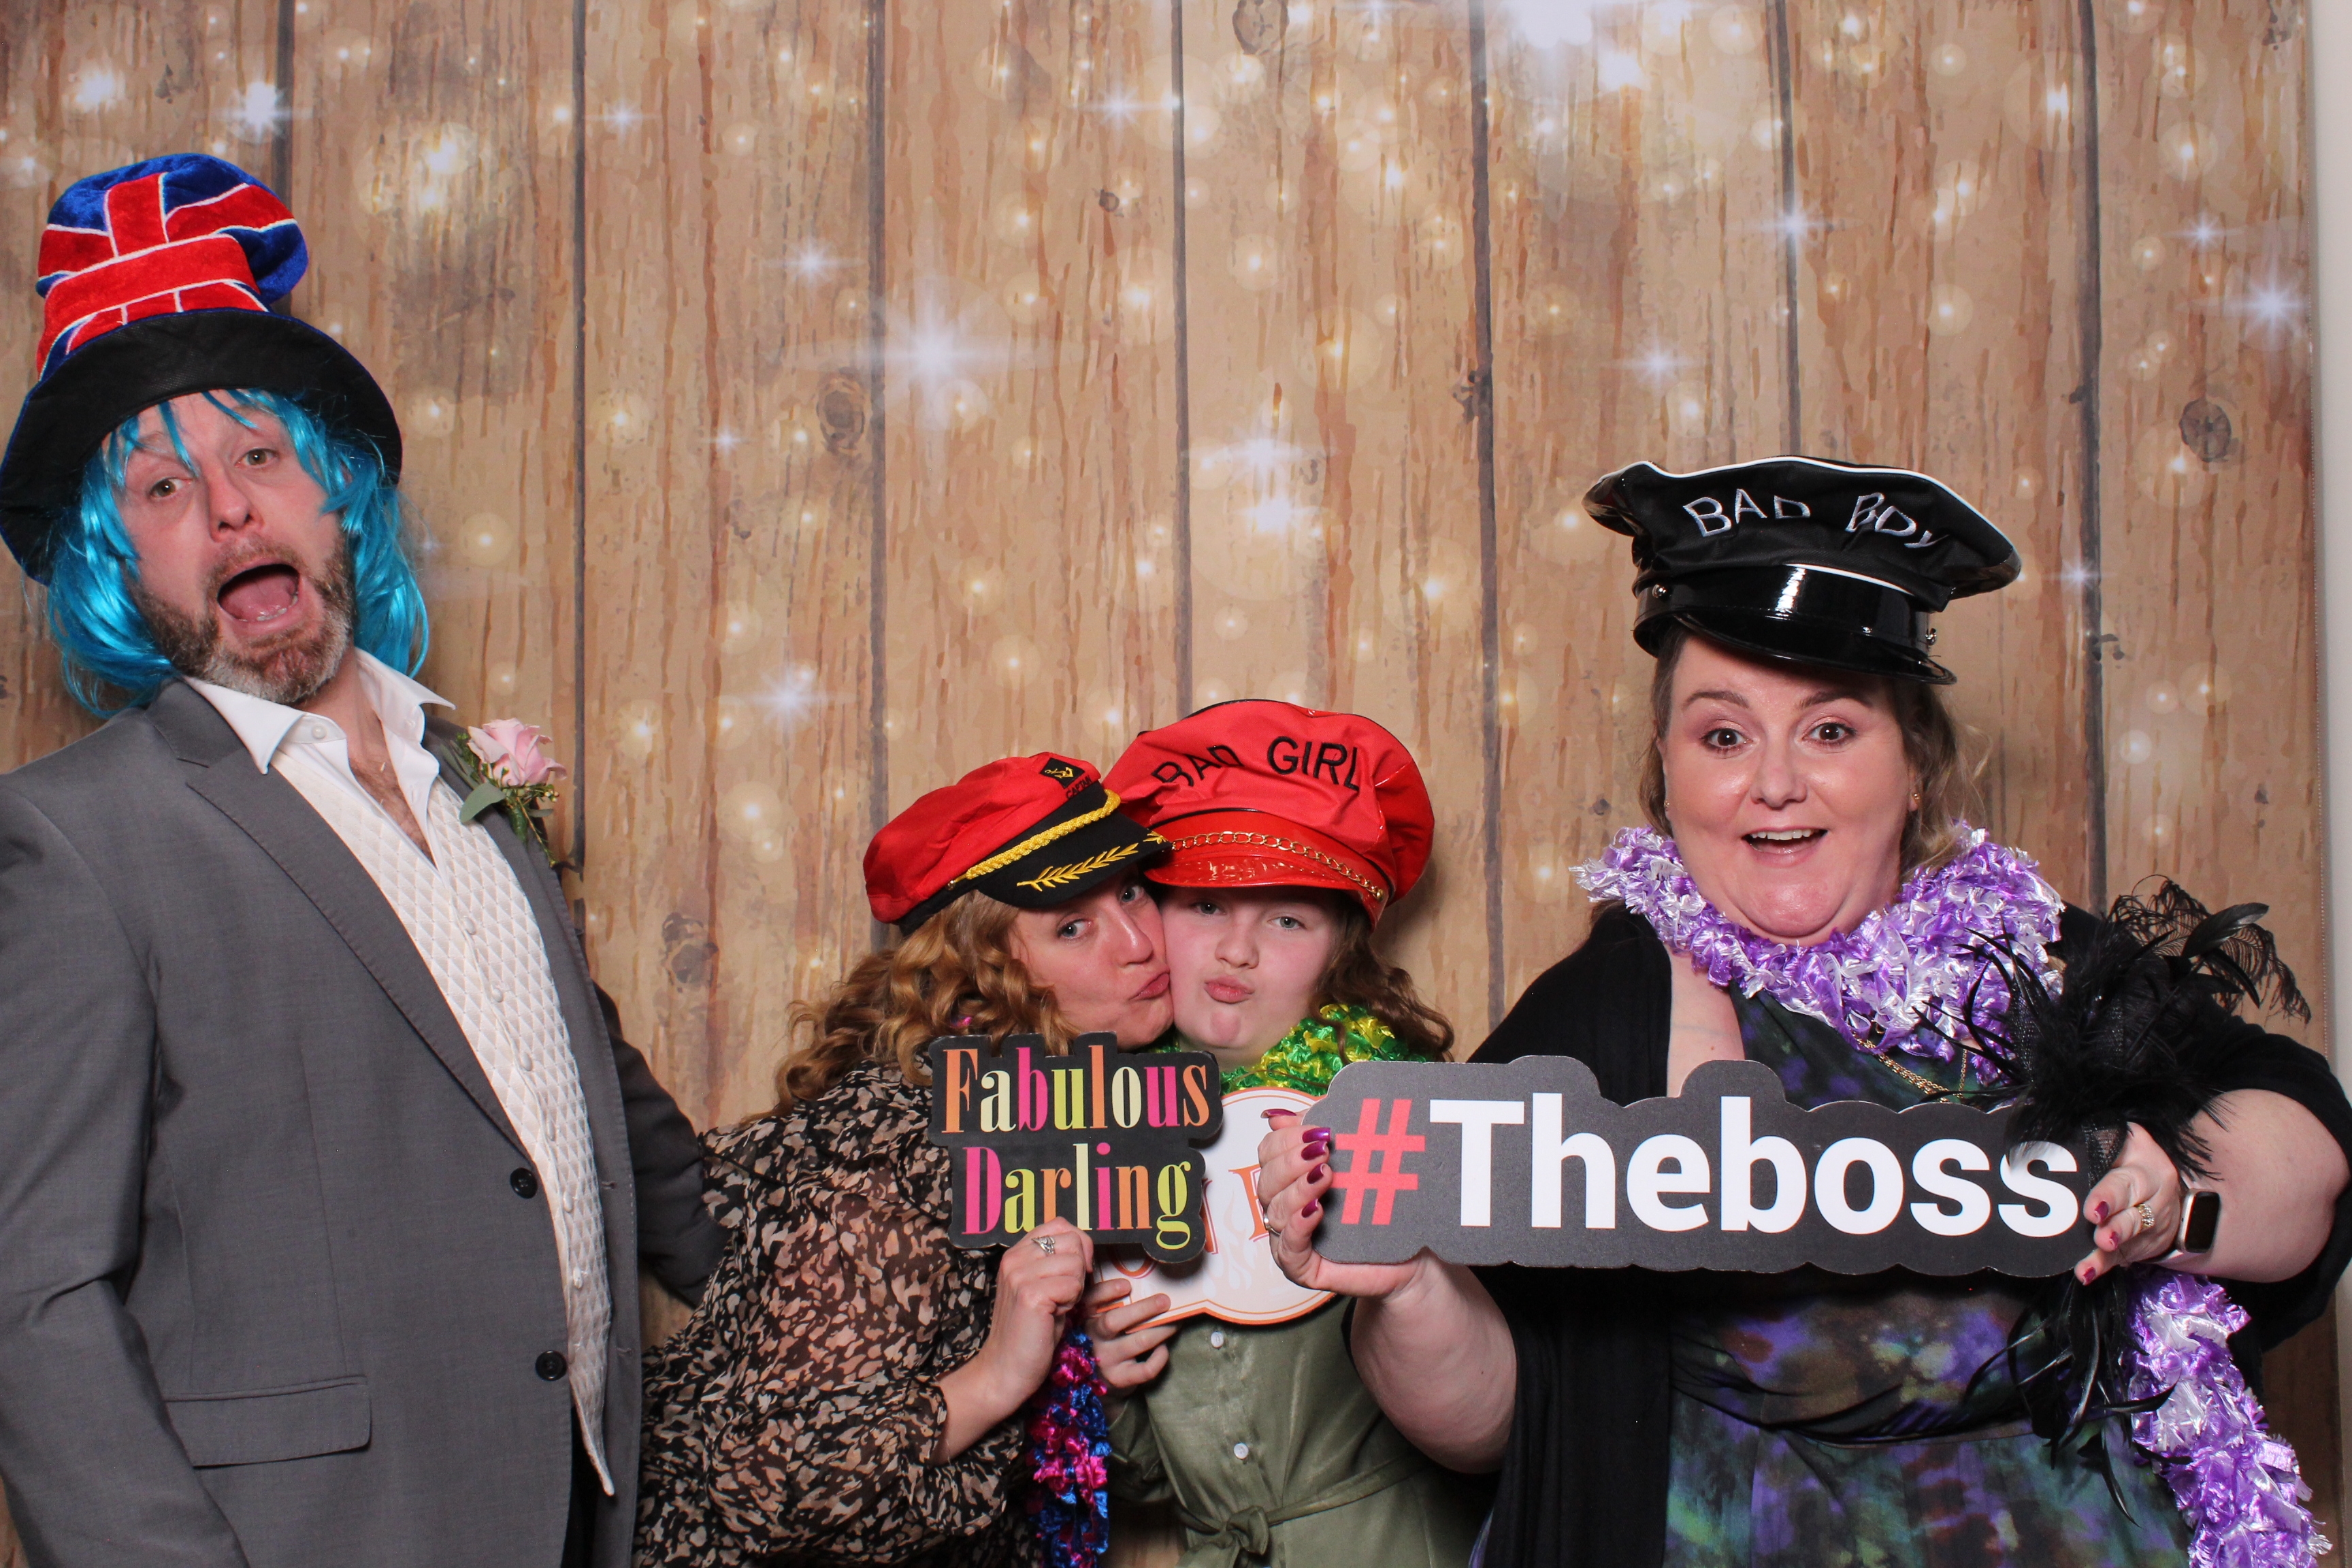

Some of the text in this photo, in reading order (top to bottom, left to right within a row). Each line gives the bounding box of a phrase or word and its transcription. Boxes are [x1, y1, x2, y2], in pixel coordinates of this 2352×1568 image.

[1683, 489, 1810, 537] BAD
[1151, 736, 1360, 791] BAD GIRL
[941, 1045, 1209, 1133] Fabulous
[962, 1142, 1191, 1250] Darling
[1333, 1092, 2078, 1237] #Theboss
